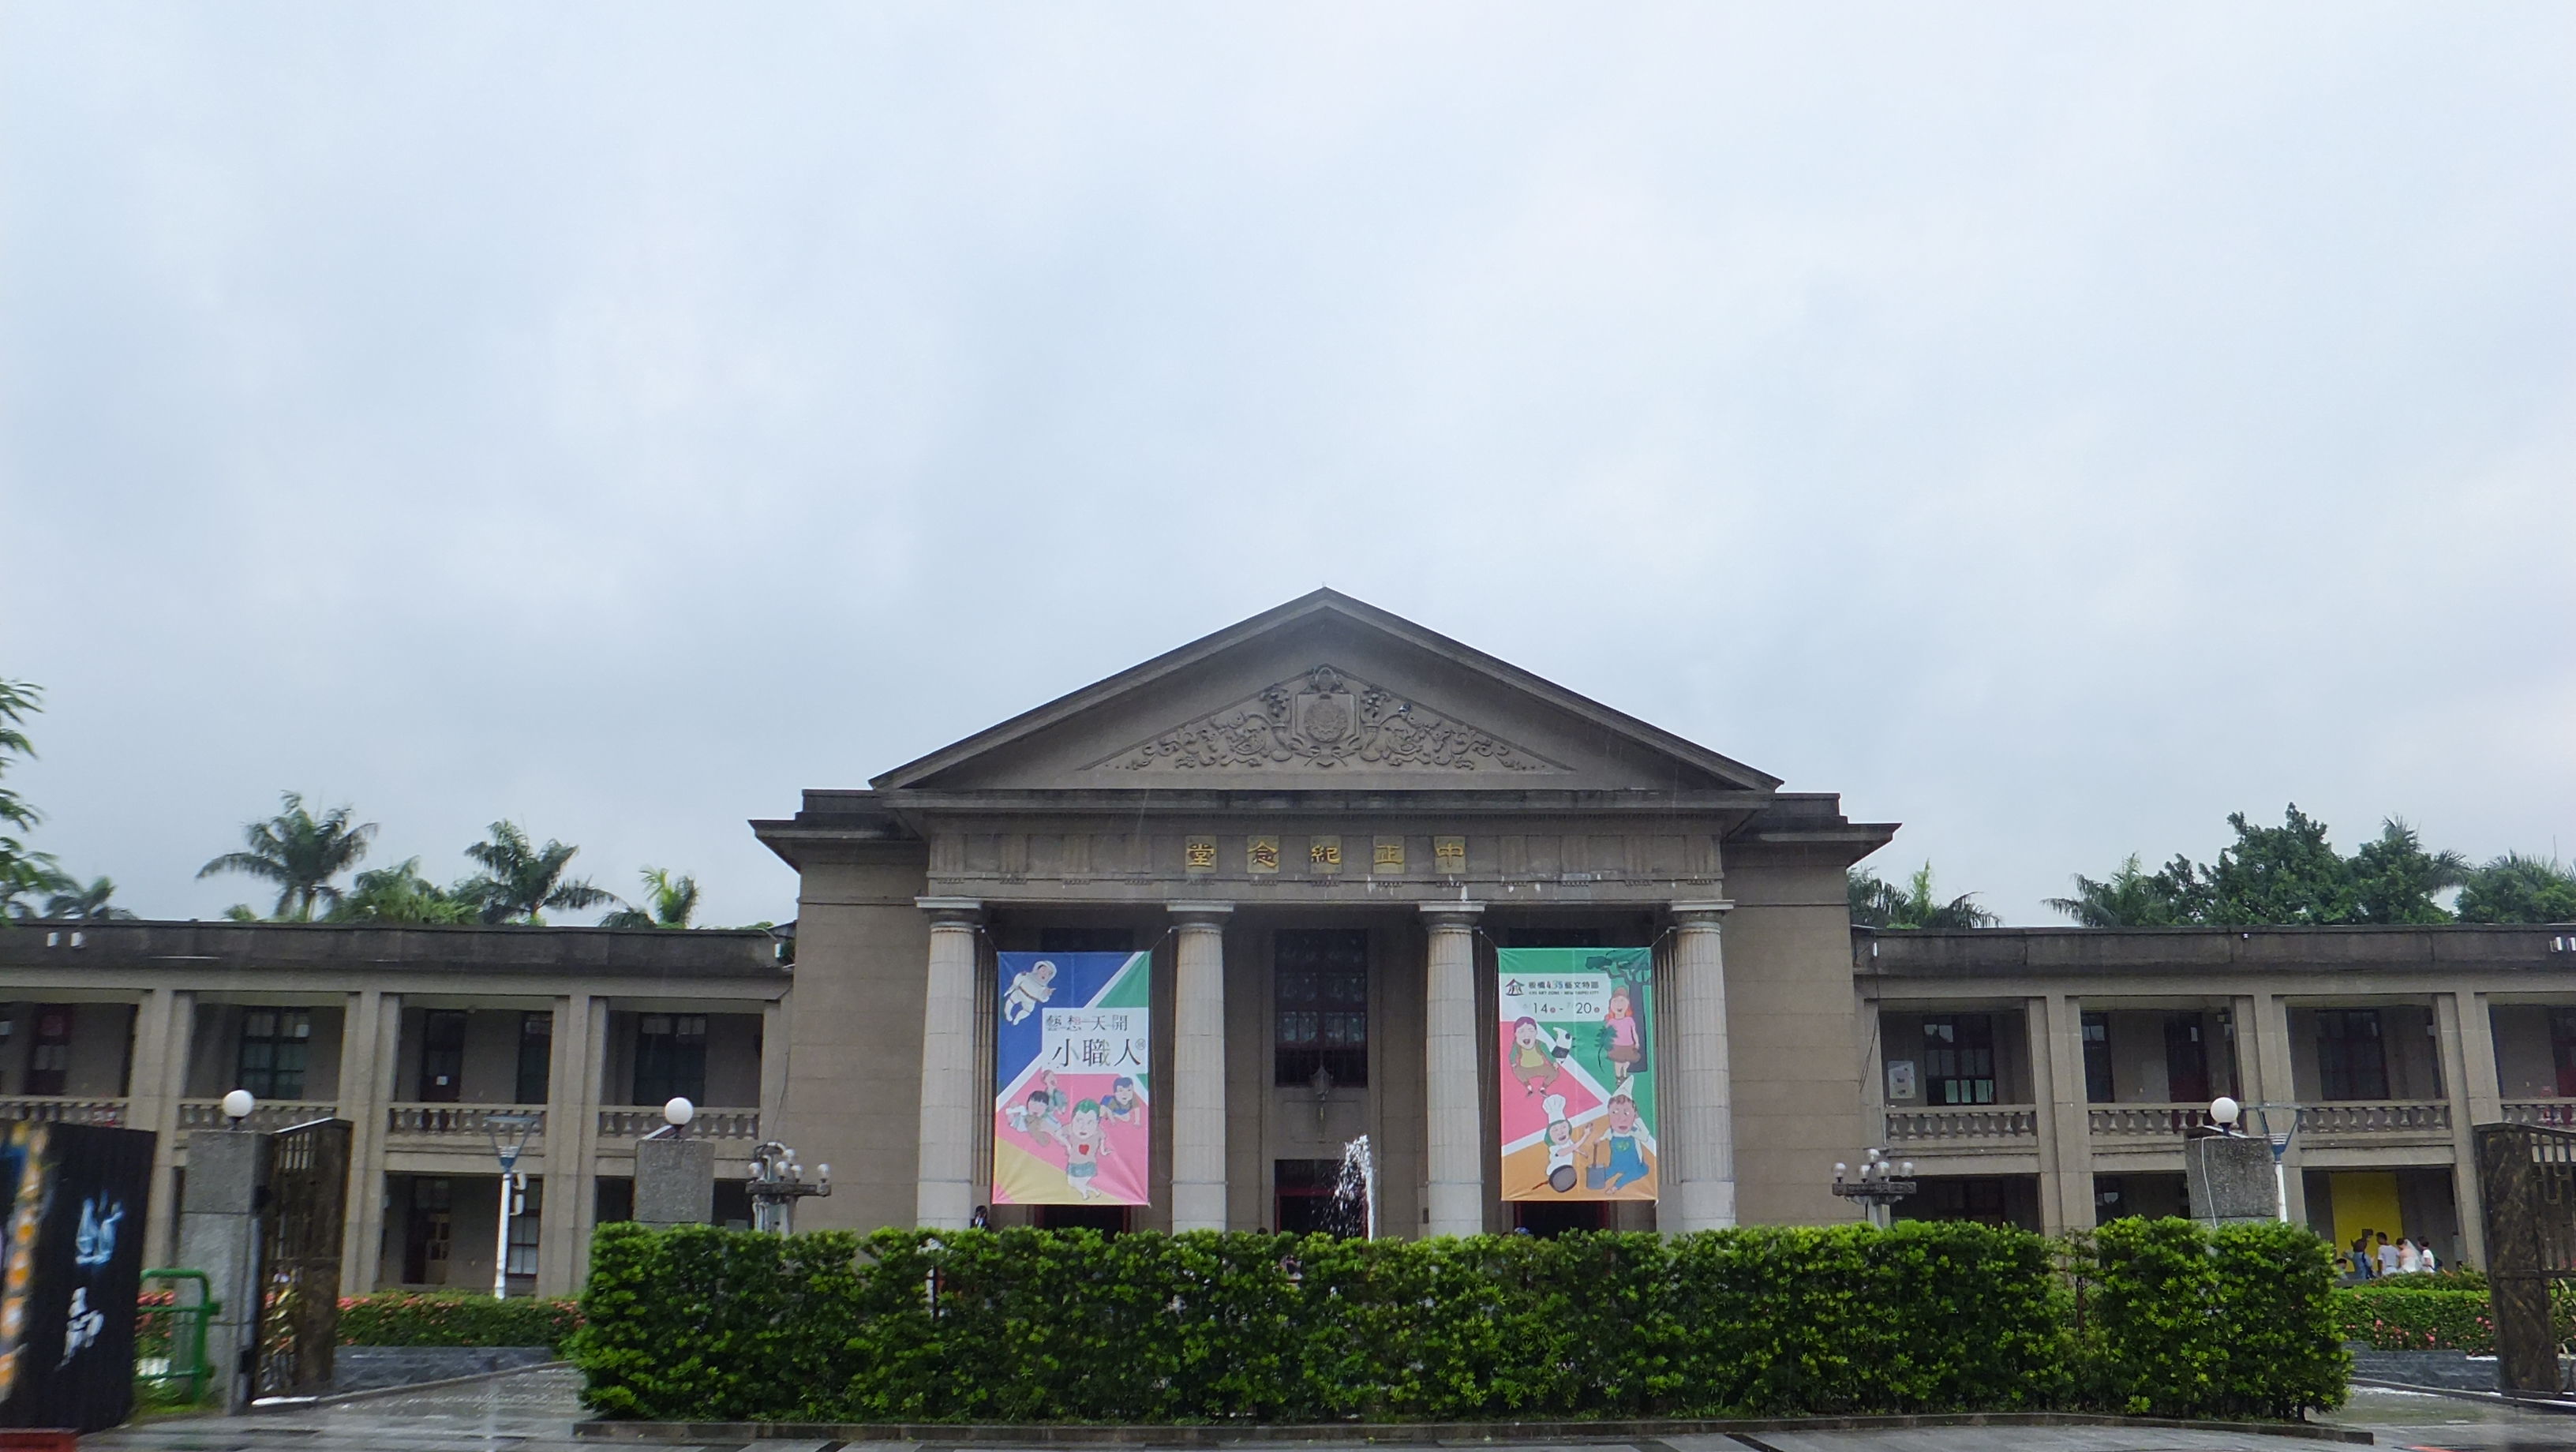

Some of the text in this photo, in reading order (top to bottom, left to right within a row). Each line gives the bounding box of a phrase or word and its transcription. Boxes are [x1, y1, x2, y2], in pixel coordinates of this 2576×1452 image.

[1186, 840, 1464, 868] 中正紀念堂
[1575, 1002, 1592, 1014] 20
[1052, 1038, 1140, 1067] 小職人
